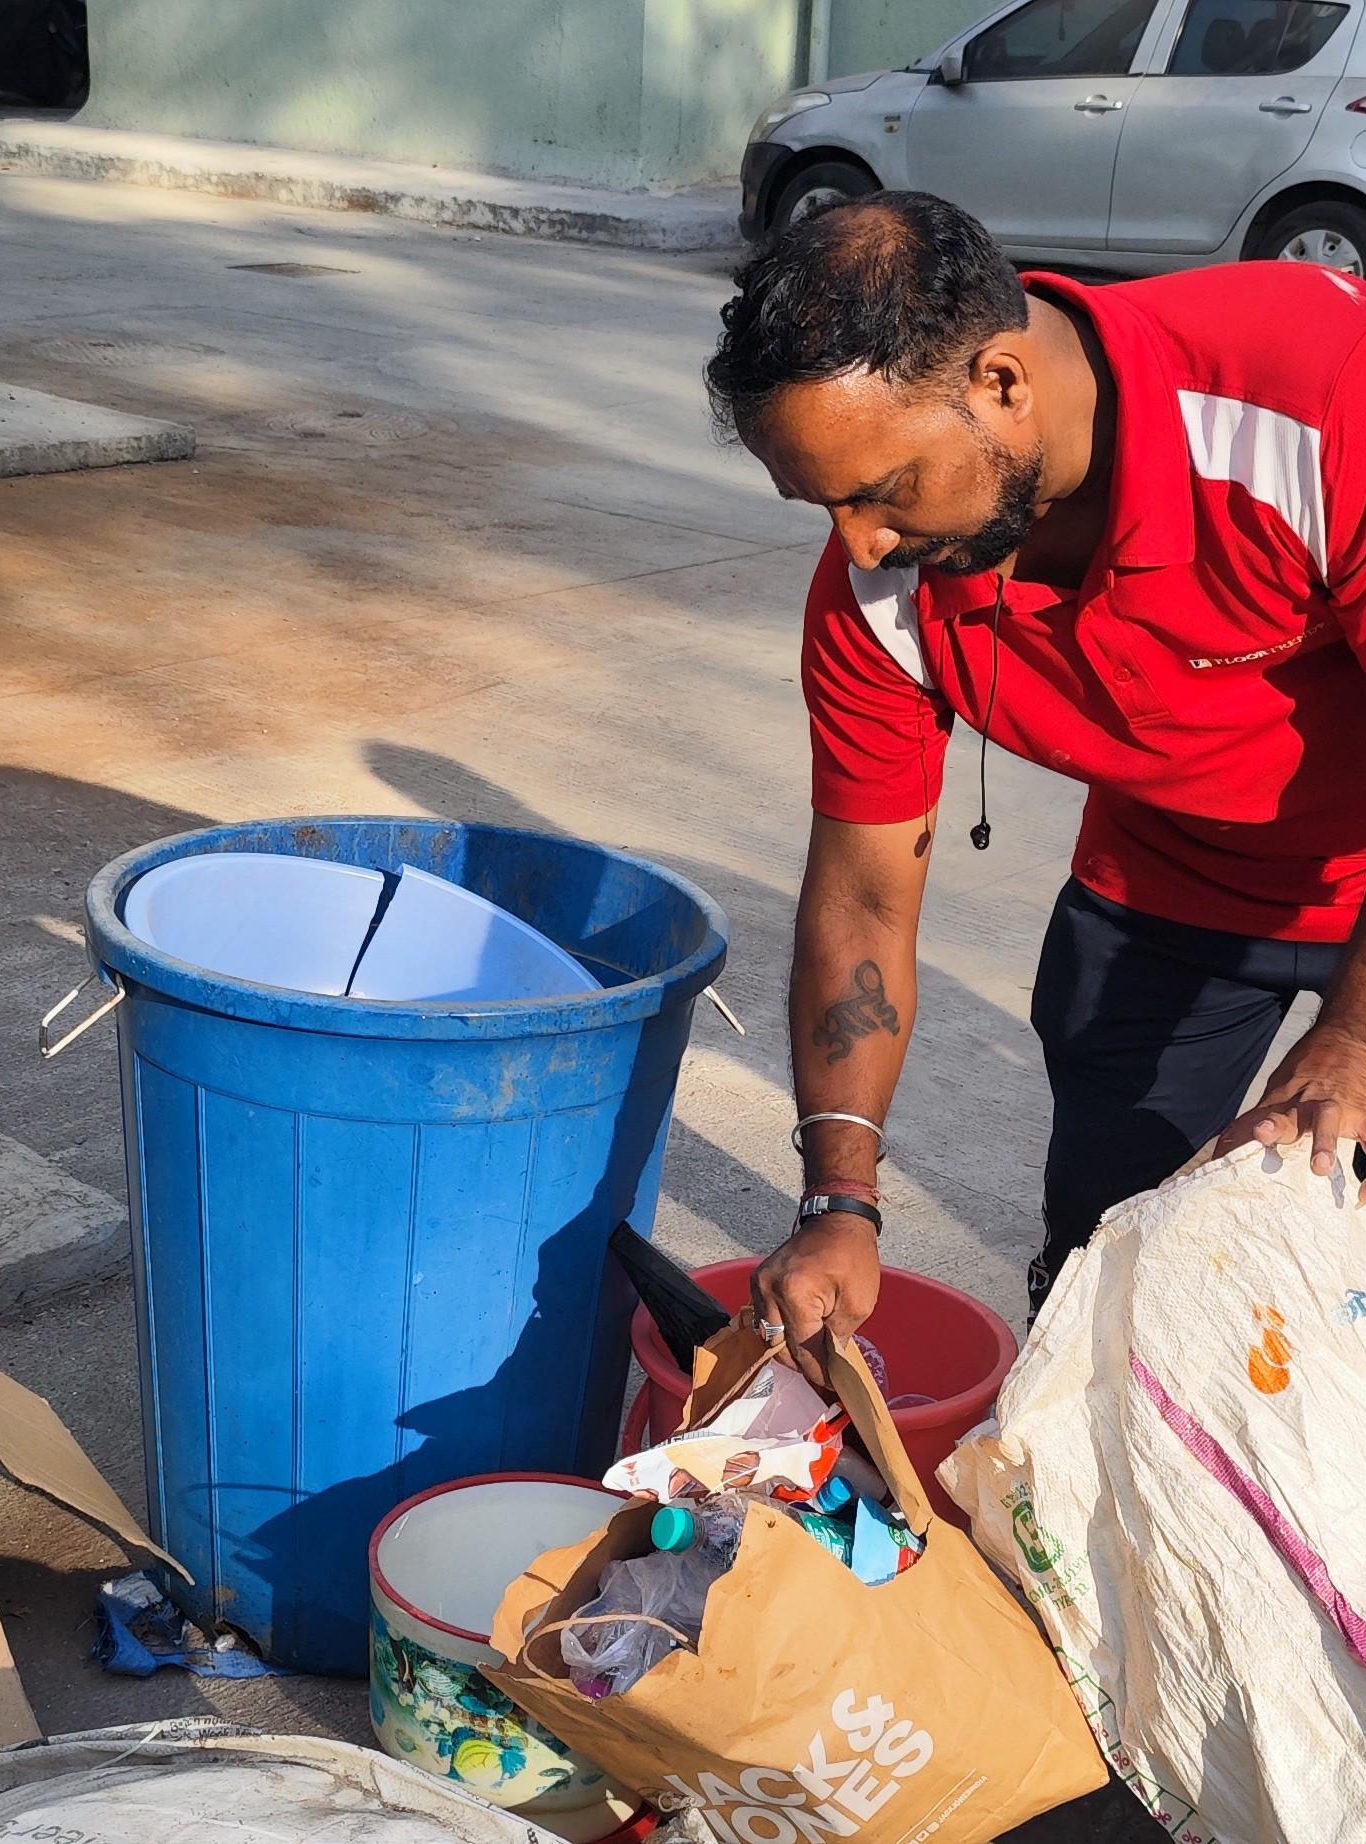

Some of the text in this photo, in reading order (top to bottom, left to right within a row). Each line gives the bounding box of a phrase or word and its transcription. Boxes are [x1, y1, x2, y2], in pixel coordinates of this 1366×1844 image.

[663, 1688, 895, 1808] JACK &
[701, 1719, 934, 1844] JONES
